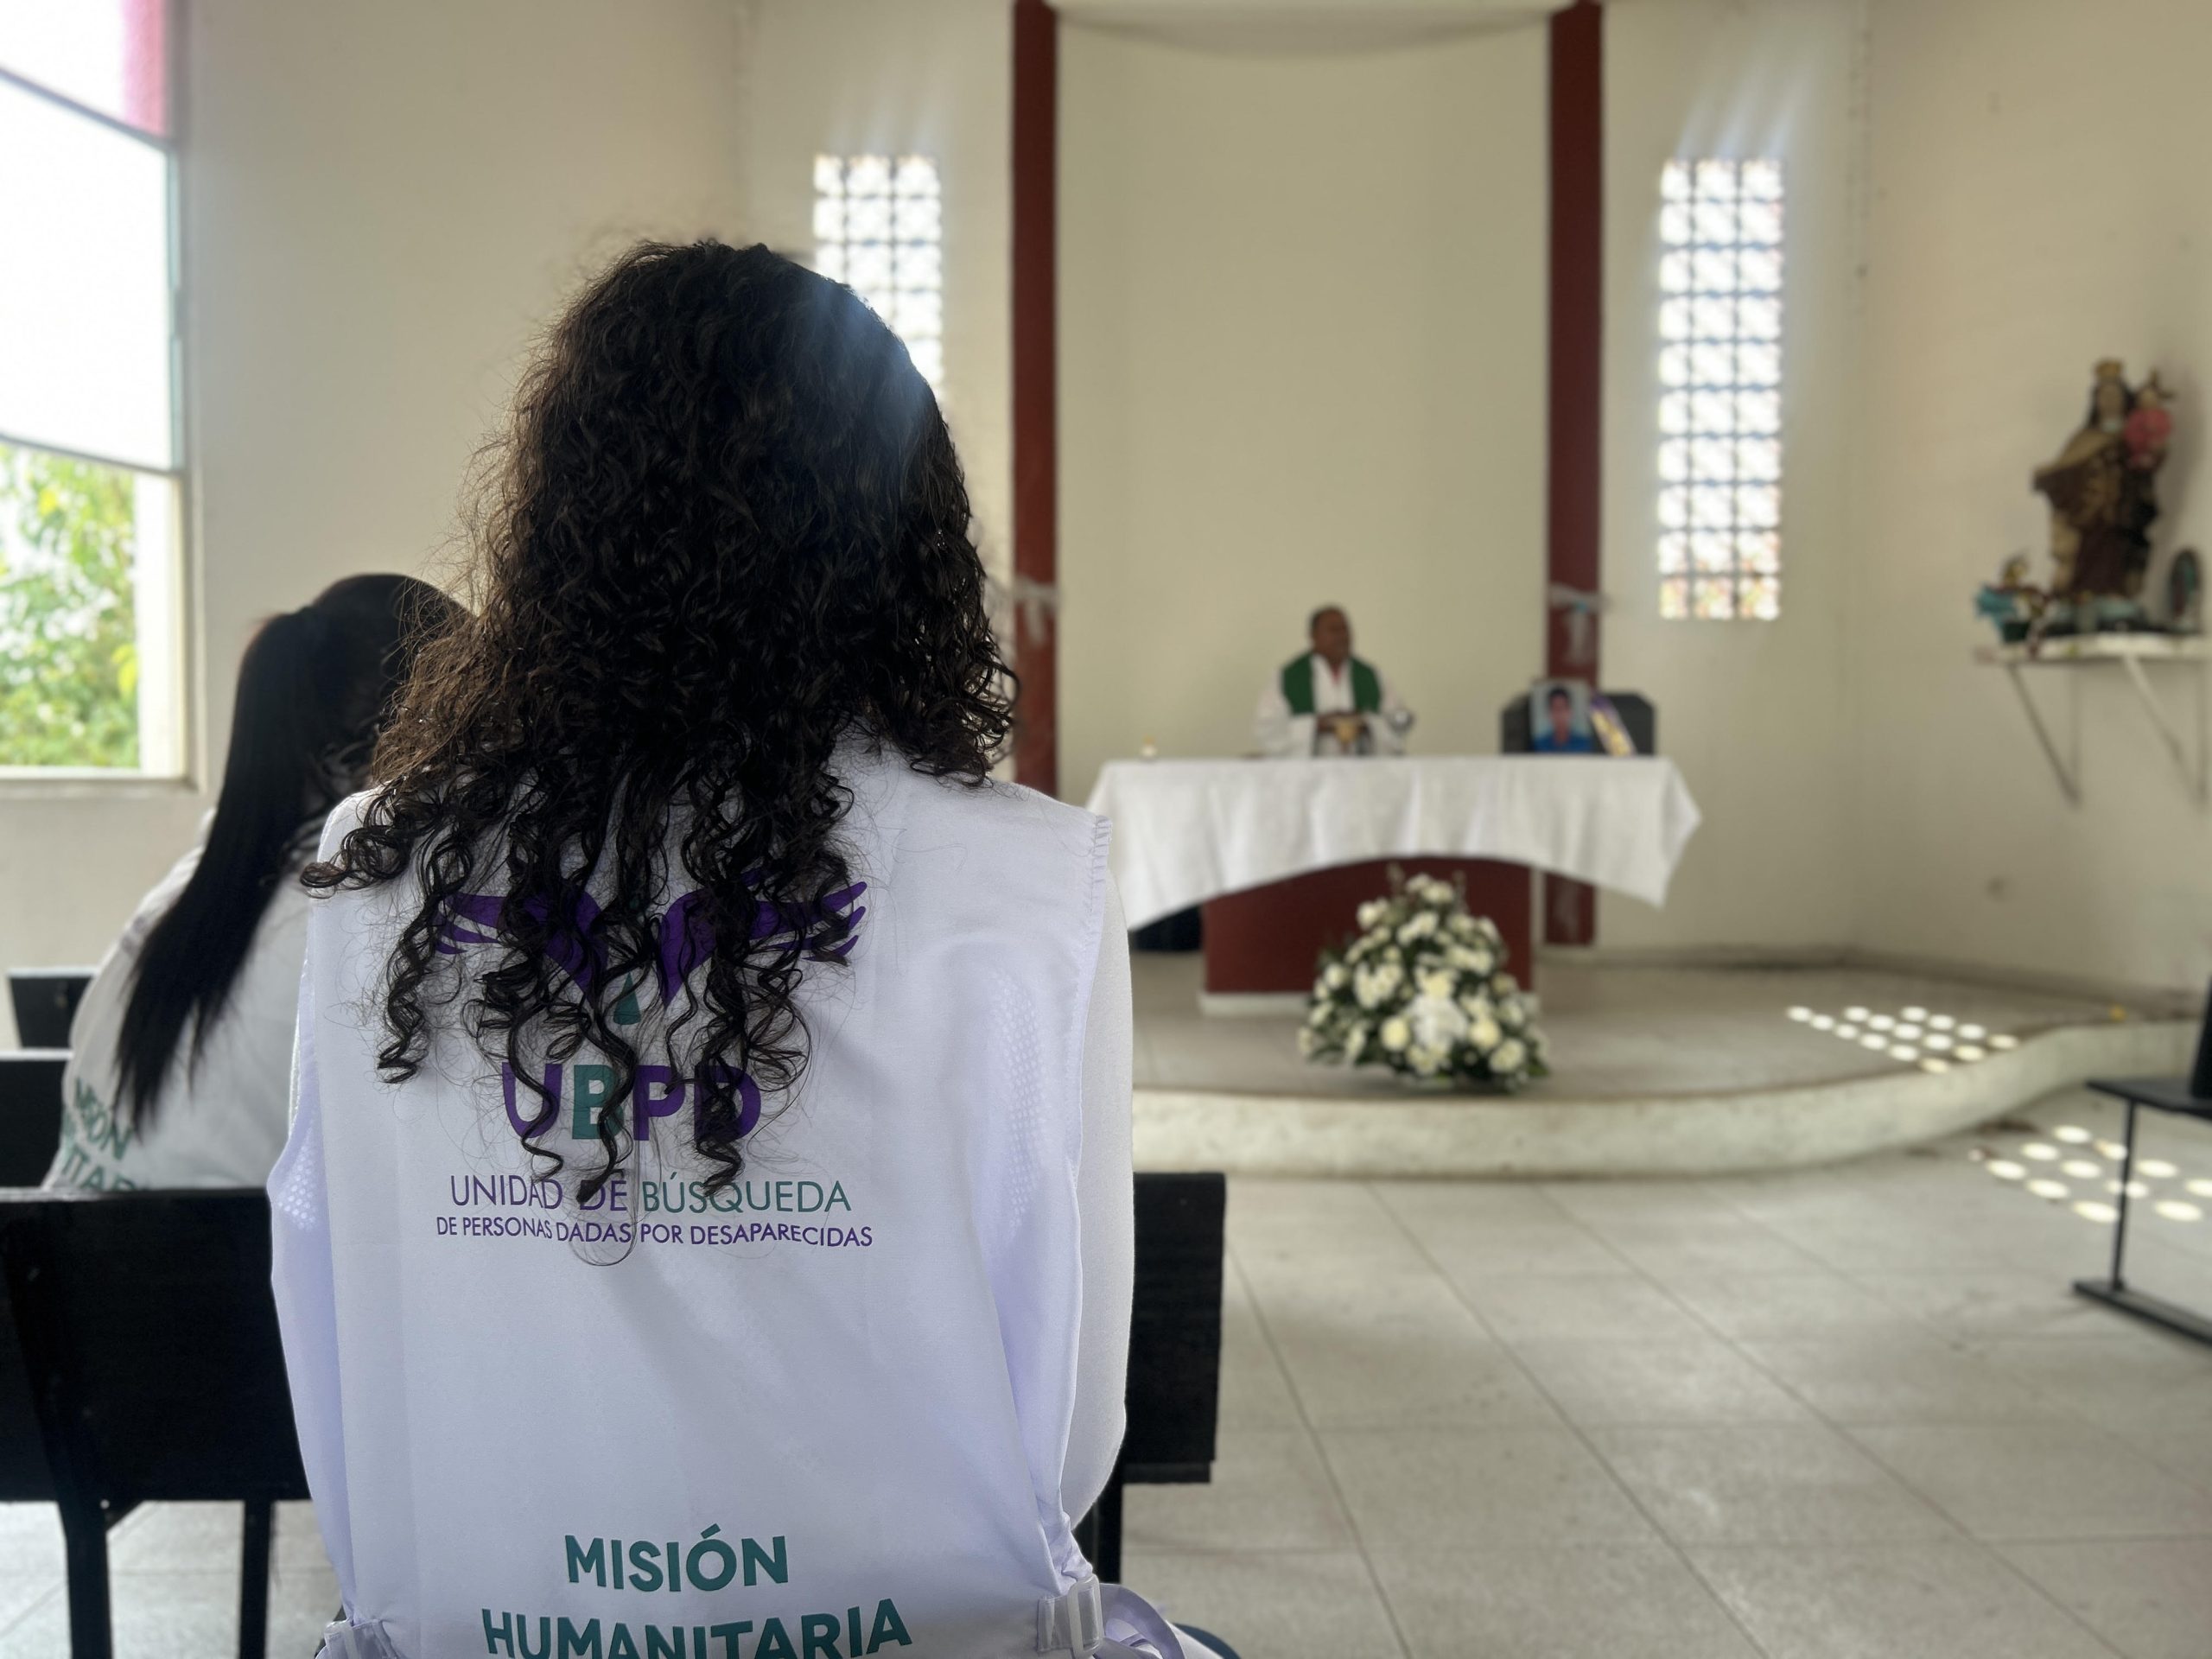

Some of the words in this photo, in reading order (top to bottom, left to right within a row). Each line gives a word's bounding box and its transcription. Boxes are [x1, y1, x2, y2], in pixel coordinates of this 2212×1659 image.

[501, 1062, 761, 1141] UBPD
[451, 1174, 563, 1209] UNIDAD
[579, 1179, 627, 1211] DE
[642, 1172, 851, 1213] BÚSQUEDA
[436, 1217, 457, 1236] DE
[463, 1217, 552, 1239] PERSONAS
[556, 1222, 632, 1243] DADAS
[640, 1224, 683, 1243] POR
[691, 1223, 873, 1247] DESAPARECIDAS
[564, 1523, 789, 1592] MISIÓN
[481, 1599, 913, 1659] HUMANITARIA
